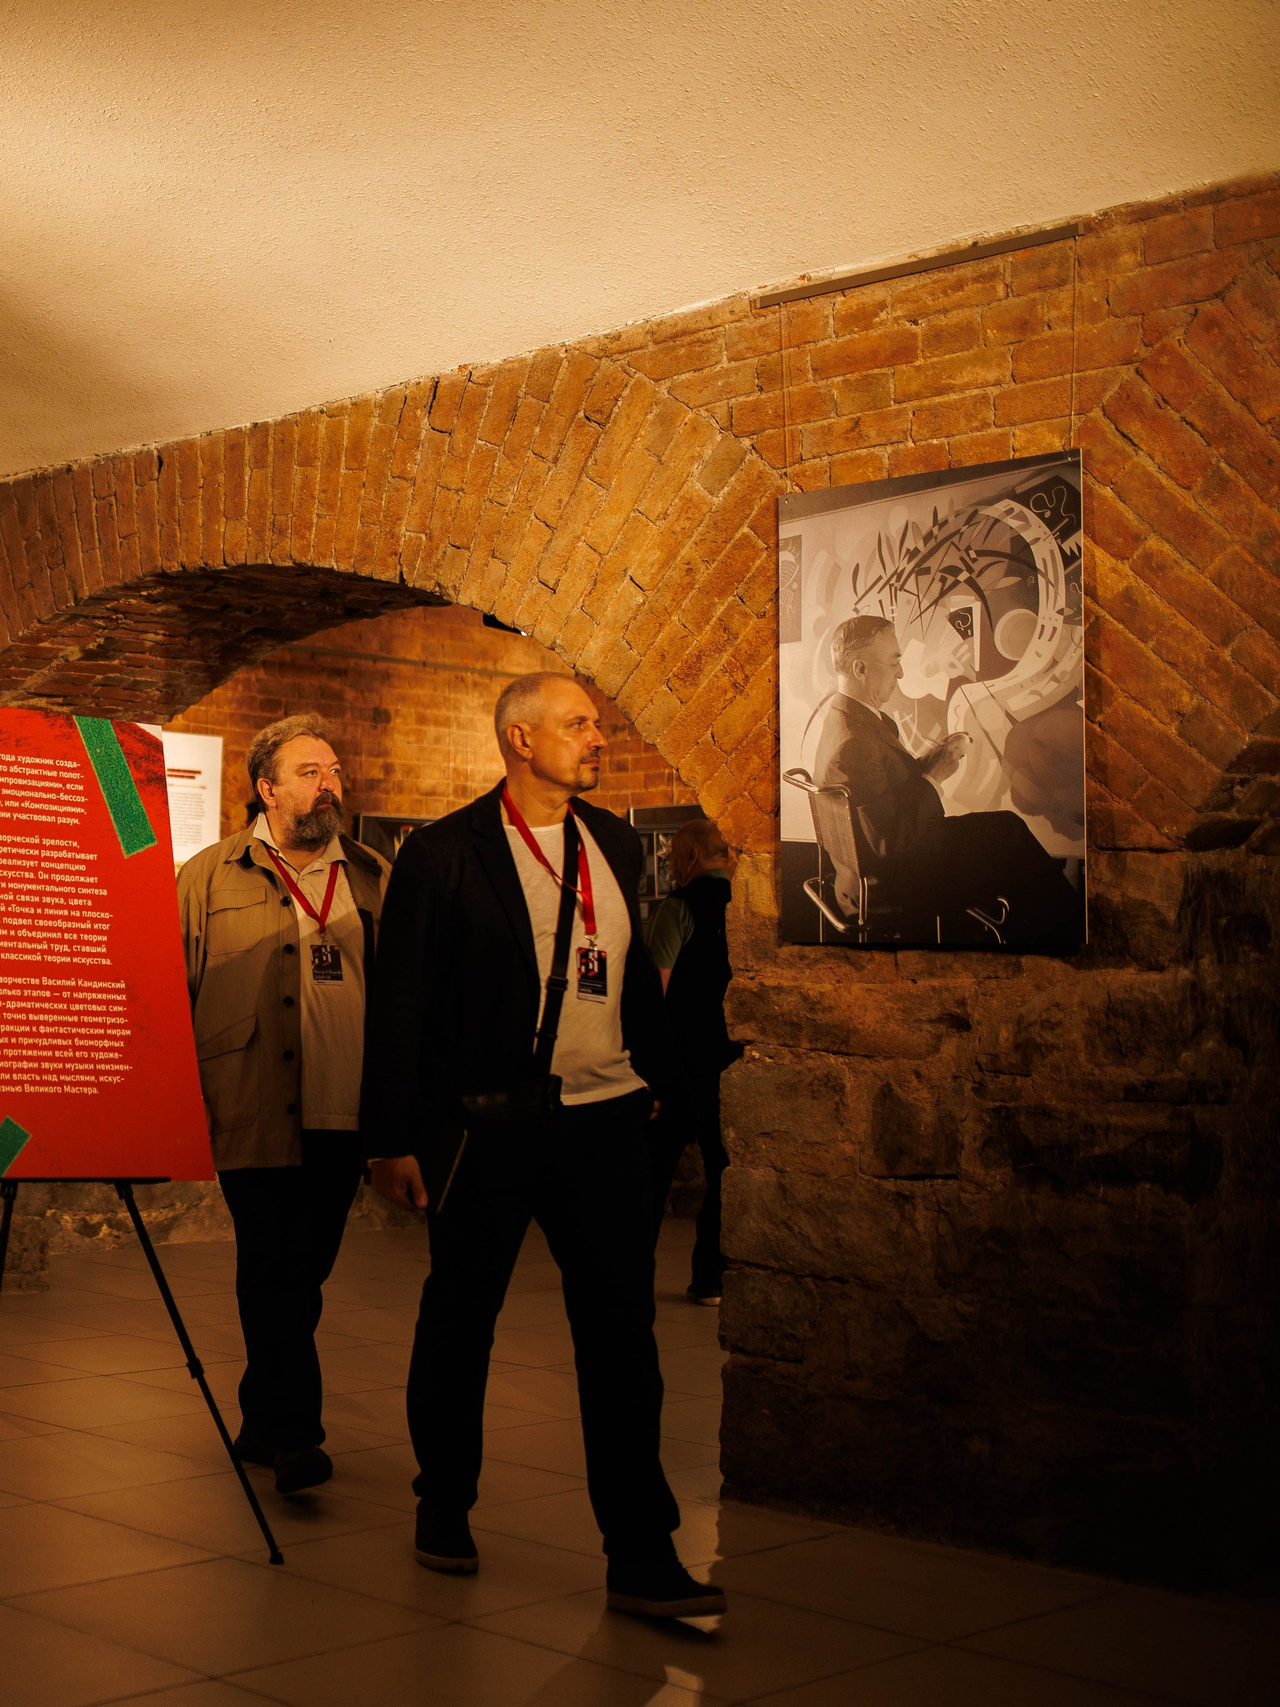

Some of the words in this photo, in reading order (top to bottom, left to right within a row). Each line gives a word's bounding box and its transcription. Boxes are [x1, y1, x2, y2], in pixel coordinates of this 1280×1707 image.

[16, 755, 54, 765] художник
[55, 759, 81, 768] созда-
[8, 765, 58, 777] абстрактные
[58, 771, 84, 779] полот-
[65, 783, 84, 791] если
[0, 788, 88, 802] эмоционально-бессоз-
[12, 812, 56, 822] участвовал
[56, 816, 80, 826] разум.
[41, 838, 80, 848] зрелости,
[40, 849, 98, 860] разрабатывает
[40, 861, 86, 871] концепцию
[37, 870, 49, 879] Он
[50, 873, 98, 883] продолжает
[7, 882, 76, 893] монументального
[77, 887, 108, 895] синтеза
[15, 894, 40, 902] связи
[41, 896, 67, 905] звука,
[68, 898, 92, 906] цвета
[7, 903, 35, 914] «Точка
[81, 910, 113, 919] плоско-
[2, 917, 33, 925] подвел
[33, 919, 92, 929] своеобразный
[16, 928, 62, 938] объединил
[63, 932, 78, 940] все
[79, 933, 108, 942] теории
[49, 943, 71, 952] труд,
[72, 944, 107, 953] ставший
[0, 952, 42, 961] классикой
[43, 955, 71, 963] теории
[72, 957, 112, 965] искусства.
[23, 1083, 62, 1093] Великого
[63, 1085, 99, 1095] Мастера.
